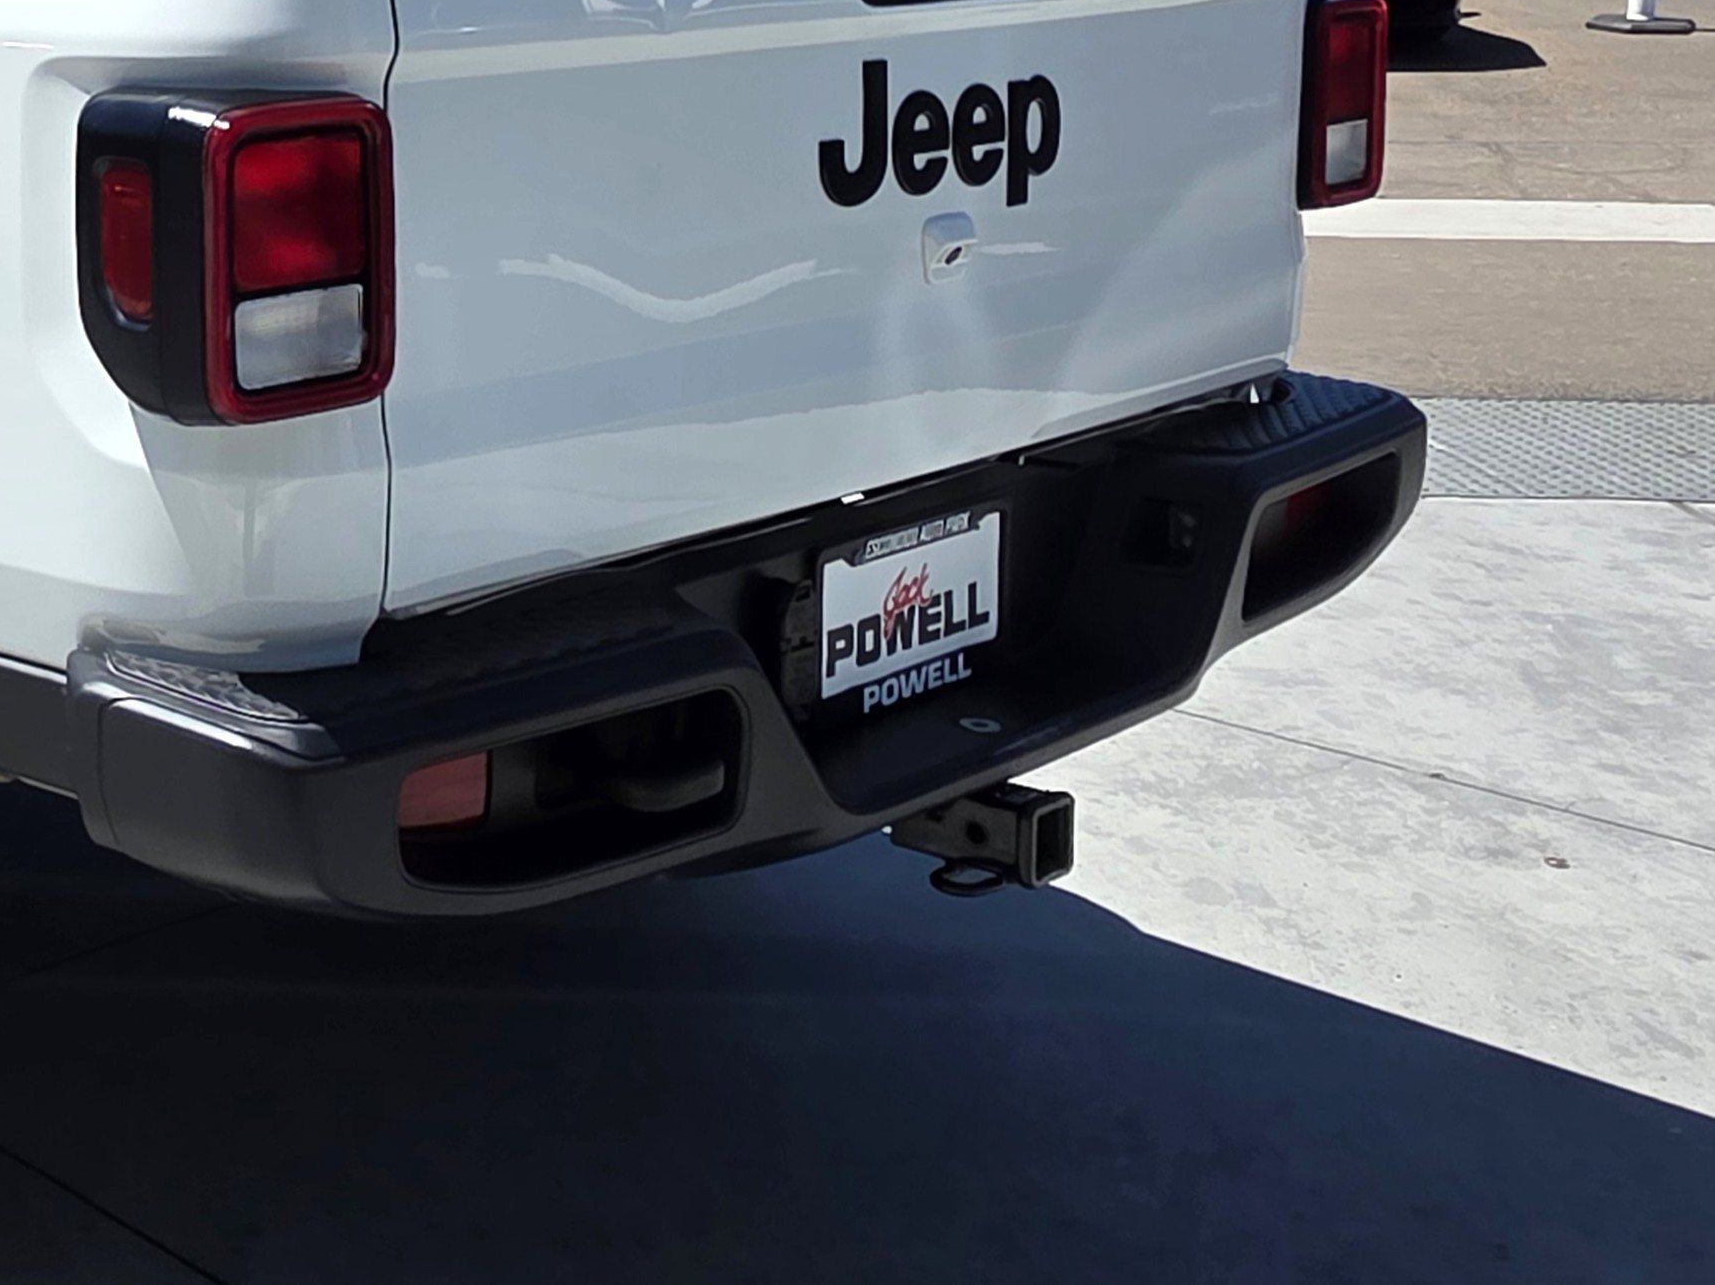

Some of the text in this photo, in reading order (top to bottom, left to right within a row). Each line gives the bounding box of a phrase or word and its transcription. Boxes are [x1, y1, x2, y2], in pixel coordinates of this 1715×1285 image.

[819, 59, 1061, 207] Jeep
[826, 581, 990, 678] POWELL
[883, 562, 934, 639] Jack
[863, 652, 972, 714] POWELL
